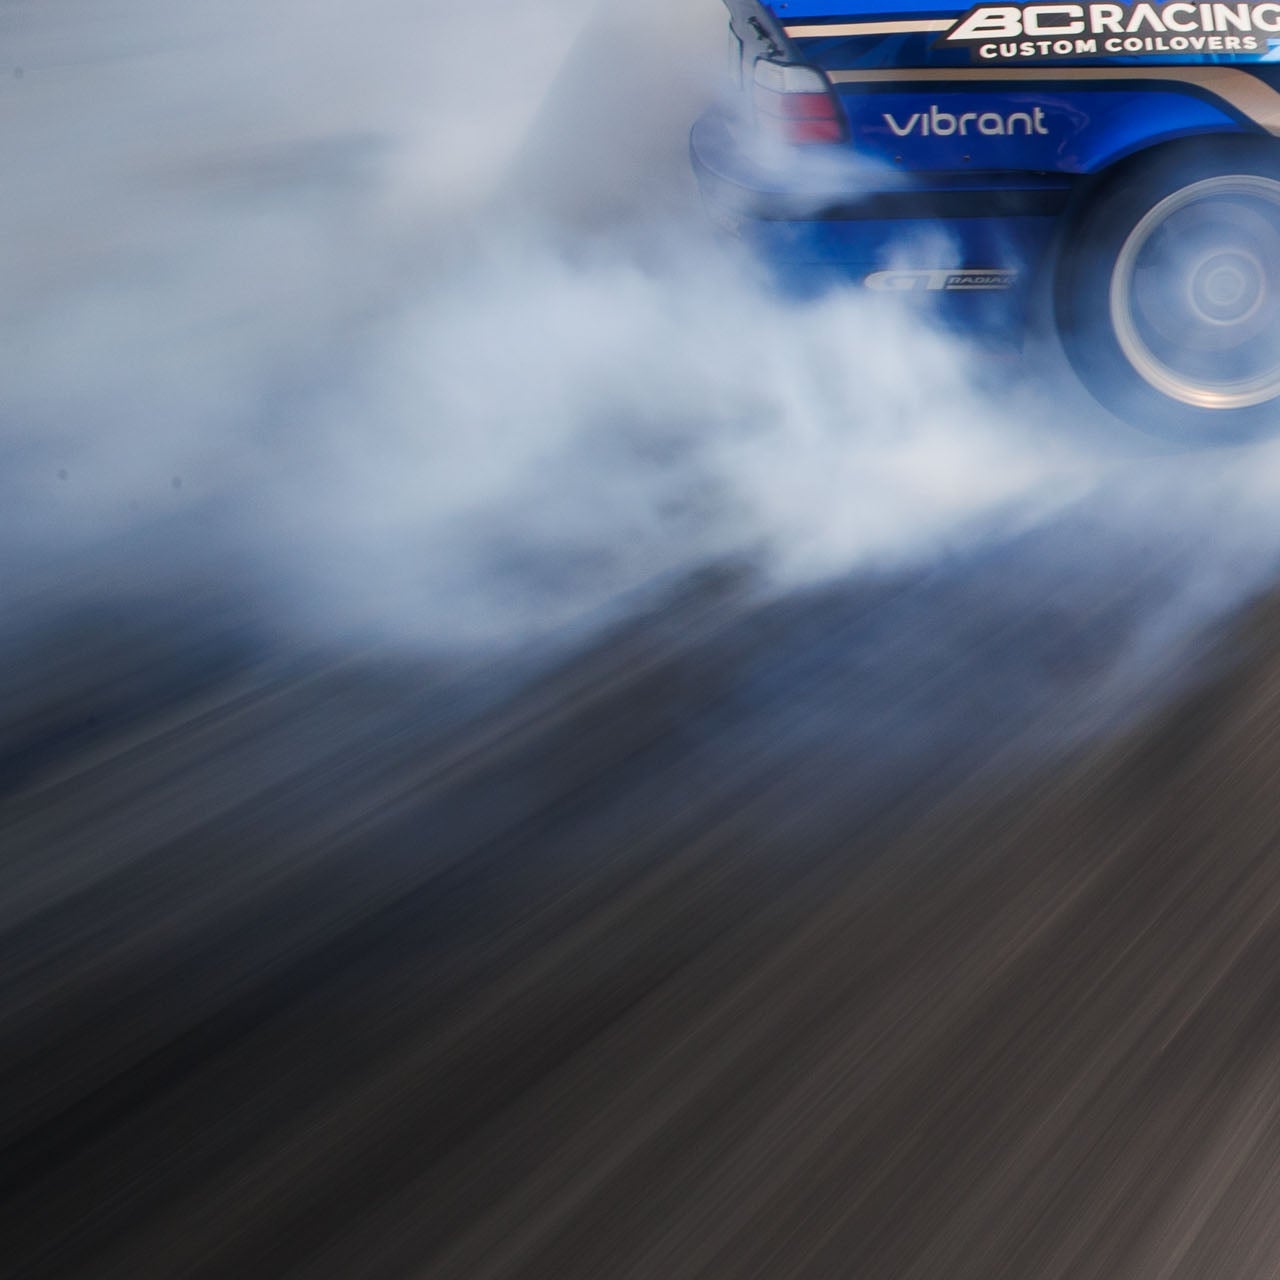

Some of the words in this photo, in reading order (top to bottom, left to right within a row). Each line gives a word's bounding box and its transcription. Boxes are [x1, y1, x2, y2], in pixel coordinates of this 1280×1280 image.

[946, 5, 1085, 41] BC
[979, 38, 1098, 59] CUSTOM
[1104, 35, 1258, 53] COILOVERS
[883, 105, 1049, 136] vibrant
